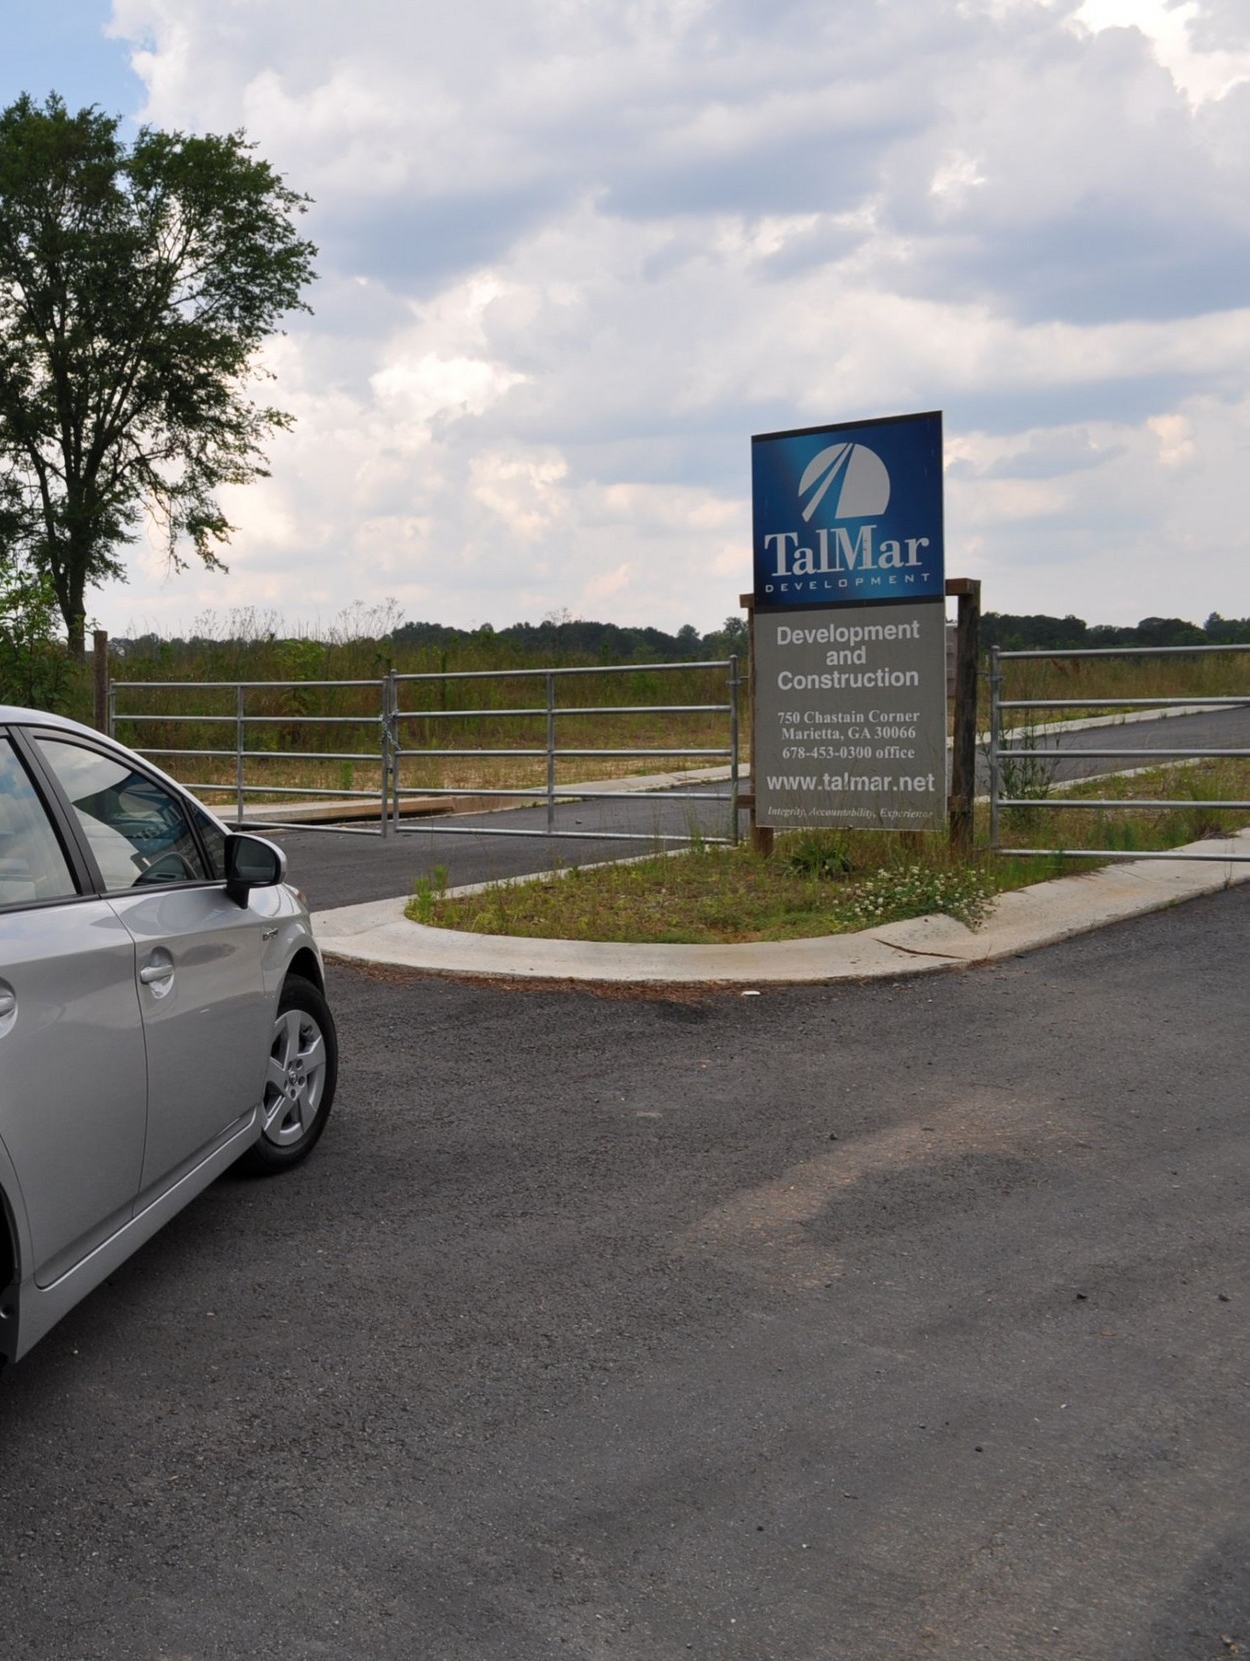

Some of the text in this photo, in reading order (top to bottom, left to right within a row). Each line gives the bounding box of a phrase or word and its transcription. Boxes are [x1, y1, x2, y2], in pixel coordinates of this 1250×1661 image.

[764, 525, 930, 577] TalMar
[765, 573, 931, 593] DEVELOPMENT
[777, 620, 920, 646] Development
[826, 646, 866, 666] and
[777, 668, 919, 690] Construction
[777, 710, 920, 724] 750 Chastain Corner
[781, 726, 916, 741] Marietta, GA 30066
[782, 746, 915, 759] 678-453-0300 office
[767, 772, 935, 792] www.talmar.net
